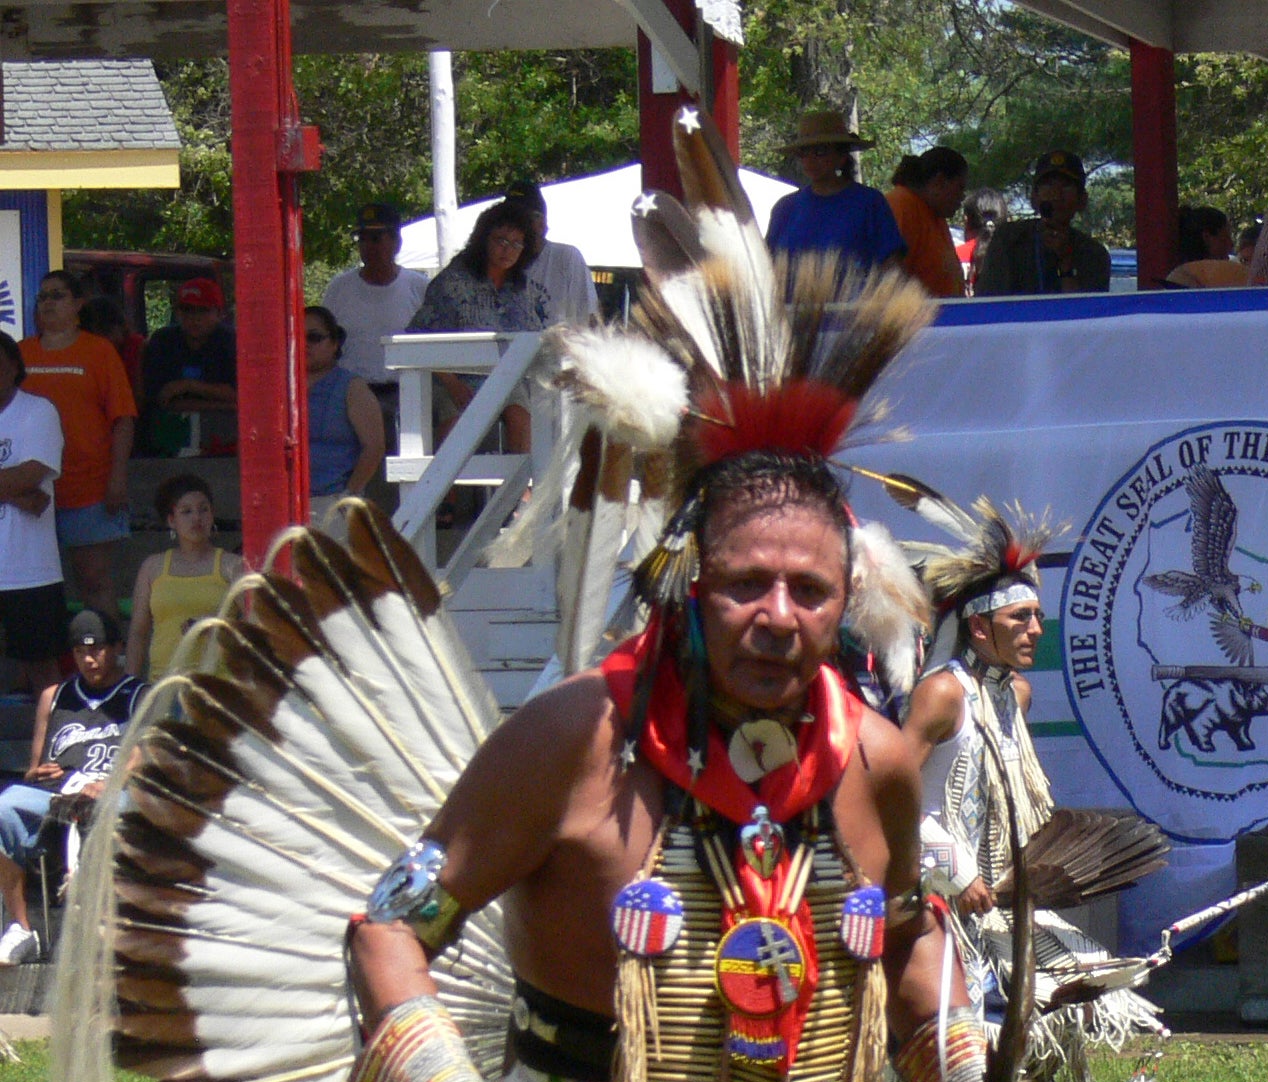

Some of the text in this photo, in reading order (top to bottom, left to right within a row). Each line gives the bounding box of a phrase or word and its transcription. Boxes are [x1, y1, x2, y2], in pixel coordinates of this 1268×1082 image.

[1178, 435, 1212, 469] OF
[1116, 453, 1173, 521] SEAL
[1070, 516, 1125, 621] GREAT
[1070, 634, 1106, 699] THE
